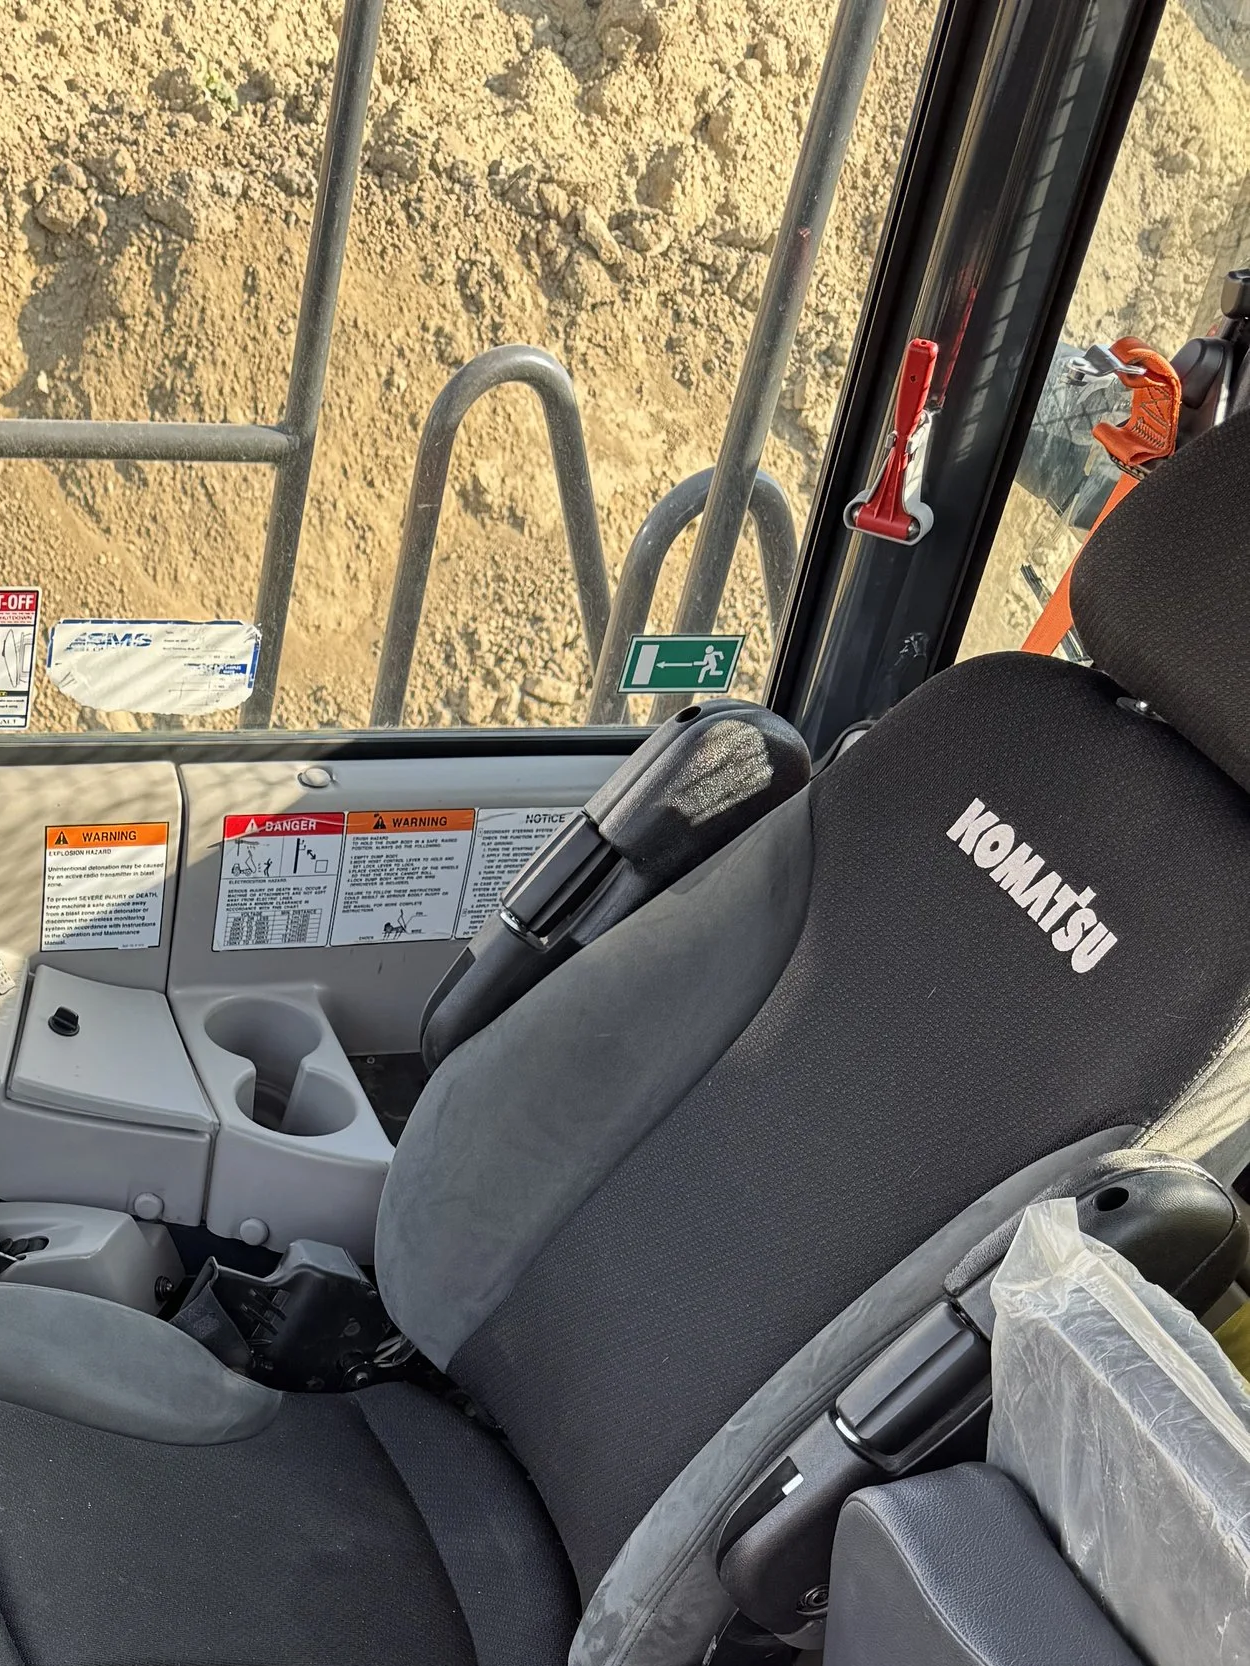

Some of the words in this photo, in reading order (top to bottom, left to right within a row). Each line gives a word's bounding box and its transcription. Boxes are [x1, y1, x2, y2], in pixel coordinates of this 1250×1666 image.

[88, 632, 152, 647] SMS
[392, 817, 447, 827] WARNING
[526, 814, 565, 823] NOTICE
[265, 820, 317, 831] DANGER
[82, 830, 137, 842] WARNING
[946, 797, 1118, 973] KOMATSU
